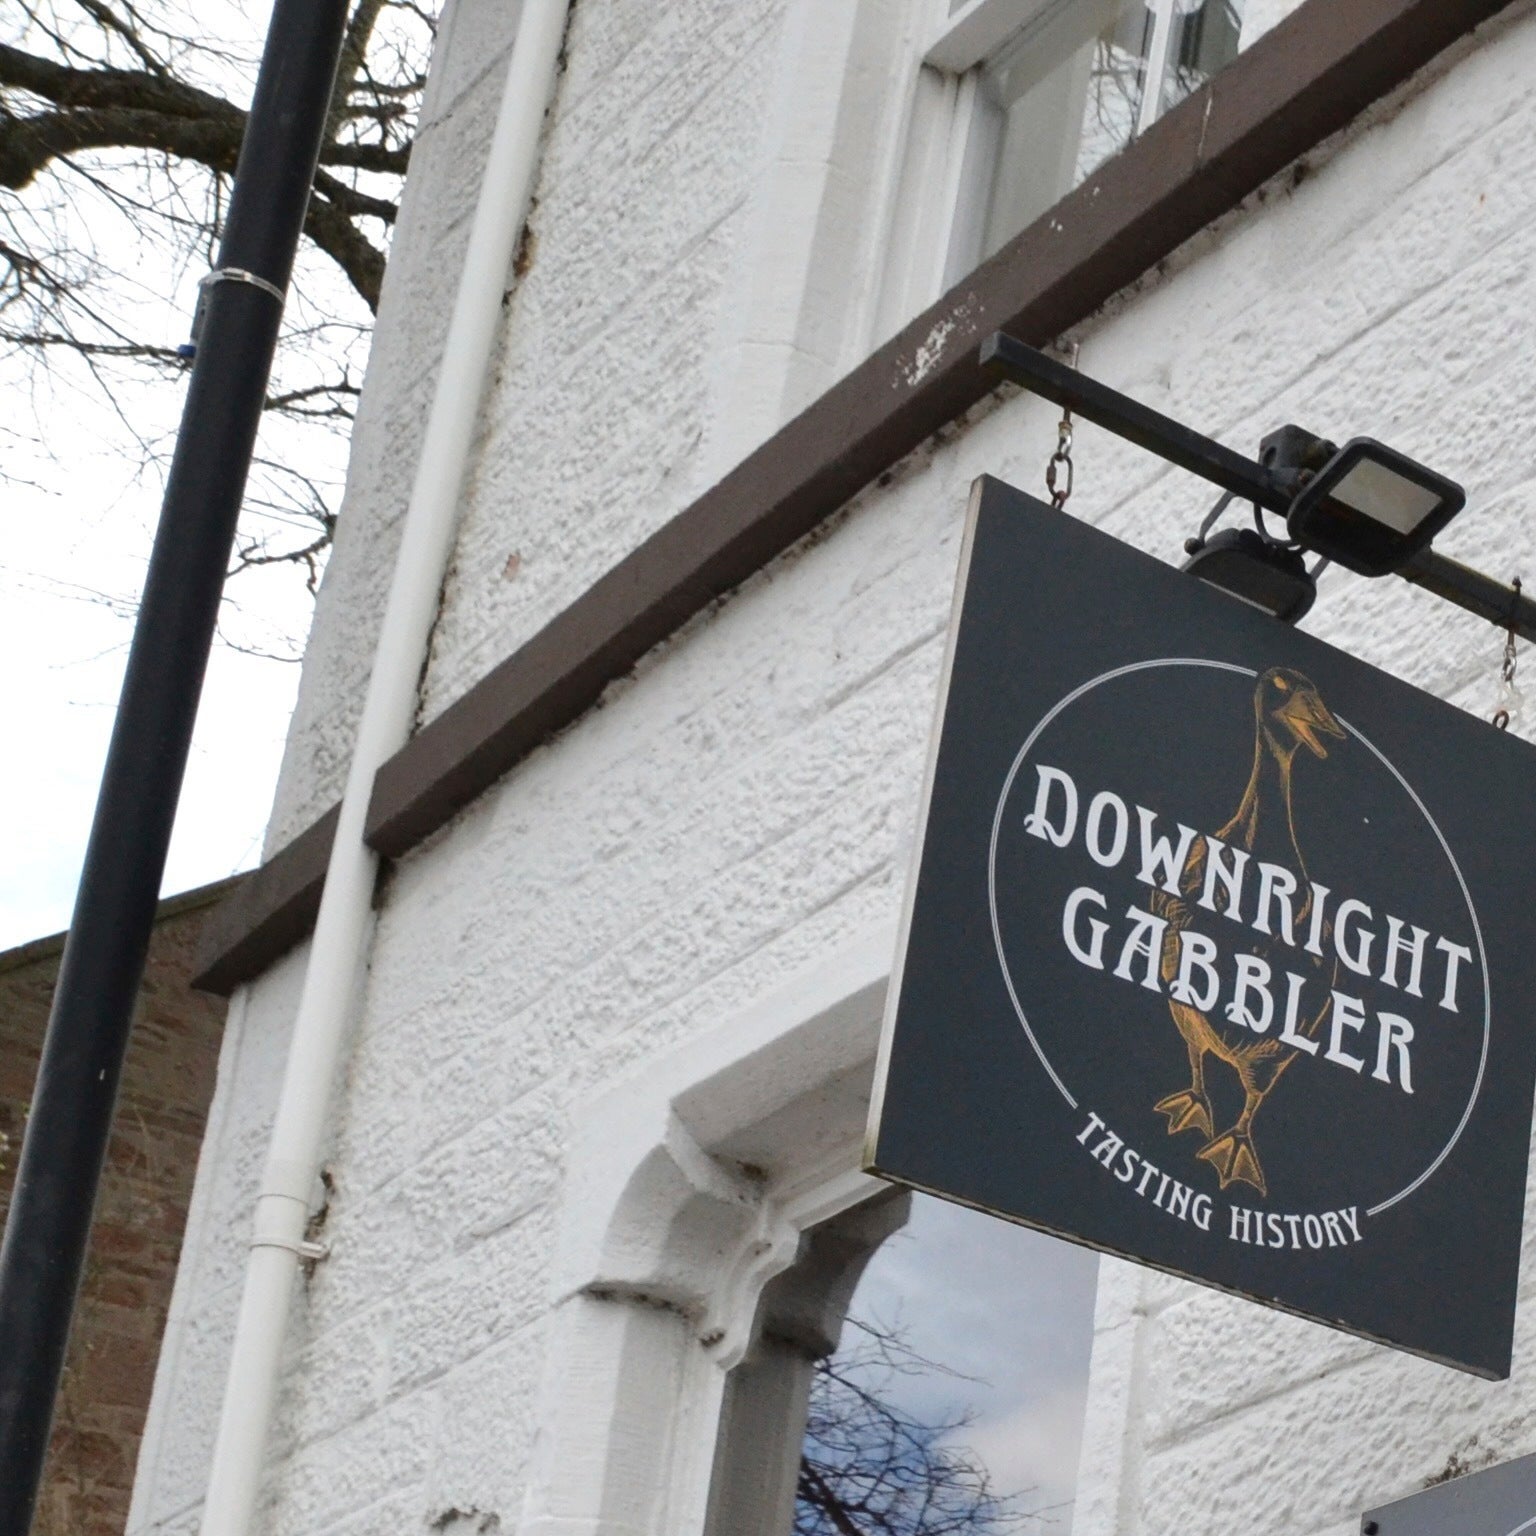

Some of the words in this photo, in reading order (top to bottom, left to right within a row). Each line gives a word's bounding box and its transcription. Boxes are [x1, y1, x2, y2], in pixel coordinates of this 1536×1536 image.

[1024, 764, 1473, 1012] DOWNRIGHT
[1063, 887, 1415, 1094] GABBLER
[1076, 1112, 1212, 1231] TASTING
[1229, 1205, 1363, 1249] HISTORY
